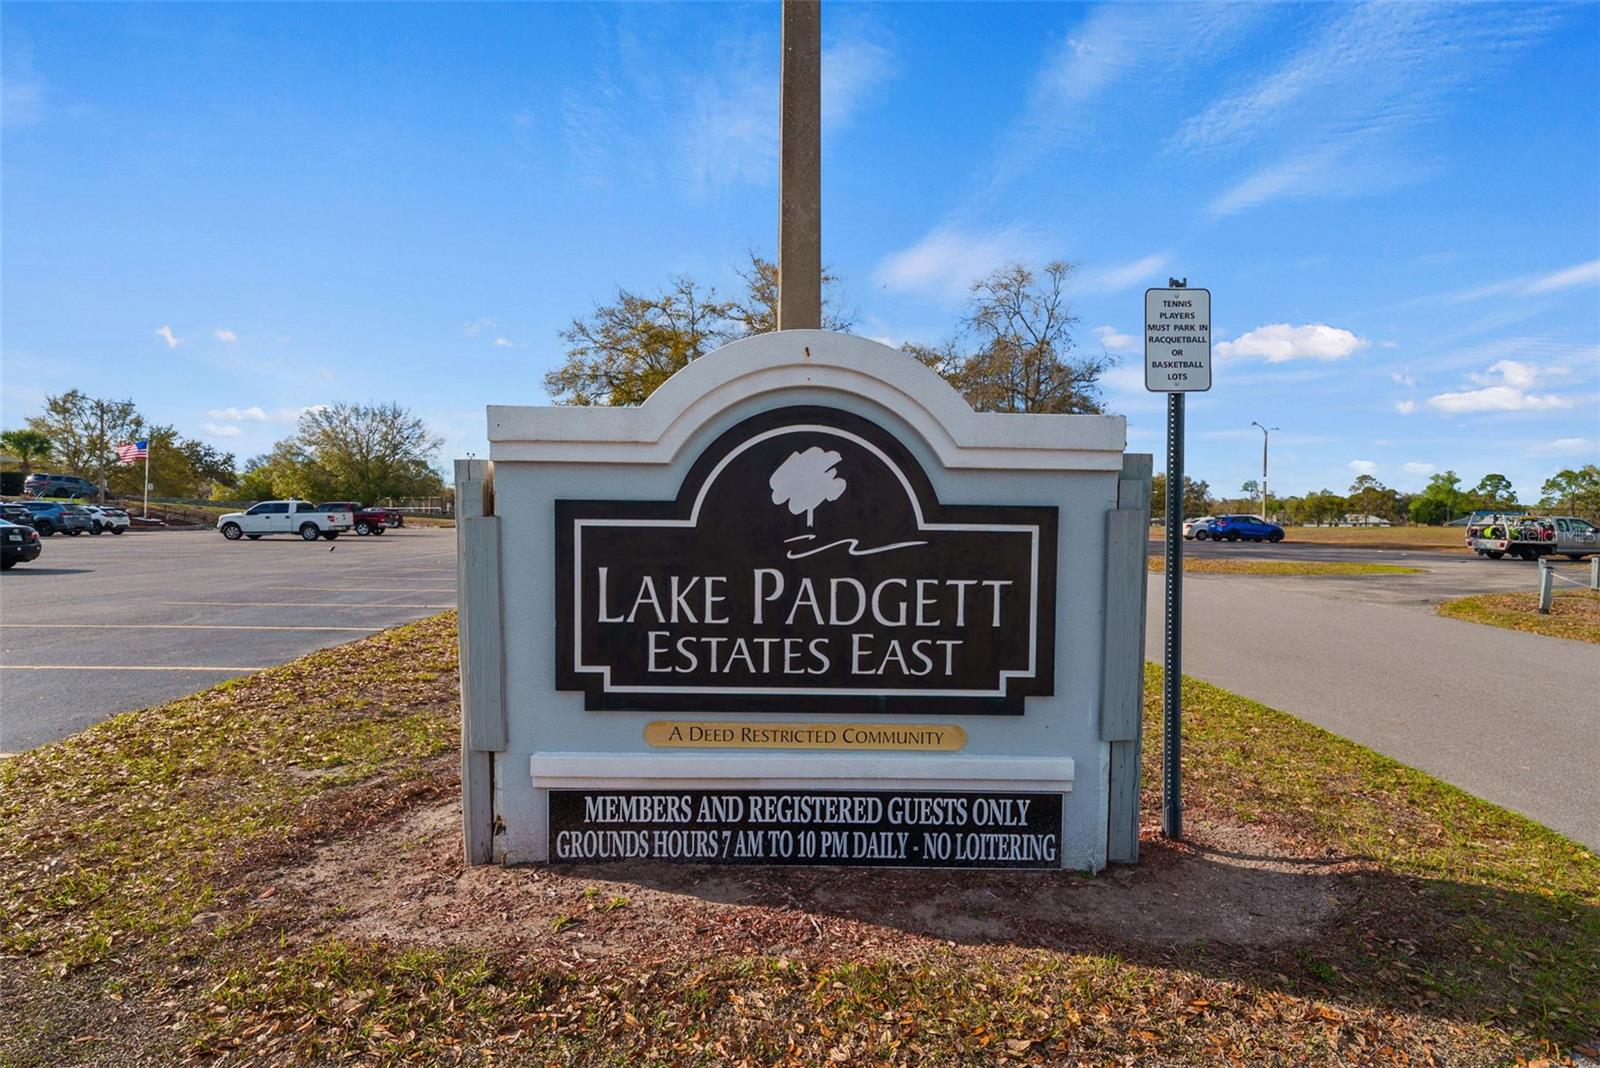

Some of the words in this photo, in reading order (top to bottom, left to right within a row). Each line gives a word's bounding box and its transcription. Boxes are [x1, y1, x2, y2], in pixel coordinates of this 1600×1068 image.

[1163, 300, 1192, 308] TENNIS
[1159, 311, 1196, 320] PLAYERS
[1147, 323, 1171, 332] MUST
[1173, 323, 1196, 332] PARK
[1198, 323, 1208, 332] IN
[1148, 335, 1207, 345] RACQUETBALL
[1171, 348, 1184, 357] OR
[1151, 360, 1204, 369] BASKETBALL
[1167, 372, 1188, 381] LOTS
[598, 567, 730, 624] LAKE
[753, 568, 1014, 627] PADGETT
[647, 631, 830, 675] ESTATES
[851, 633, 965, 676] EAST
[668, 725, 683, 742] A
[689, 726, 735, 742] DEED
[741, 726, 837, 744] RESTRICTED
[842, 727, 945, 745] COMMUNITY
[583, 795, 692, 823] MEMBERS
[696, 796, 744, 823] AND
[748, 796, 883, 824] REGISTERED
[887, 797, 968, 825] GUESTS
[973, 798, 1031, 826] ONLY
[556, 830, 649, 858] GROUNDS
[652, 830, 718, 858] HOURS
[721, 830, 732, 858] 7
[734, 830, 764, 857] AM
[768, 830, 793, 858] TO
[797, 830, 816, 858] 10
[820, 831, 849, 858] PM
[852, 831, 909, 859] DAILY
[922, 832, 951, 860] NO
[955, 832, 1056, 861] LOITERING
